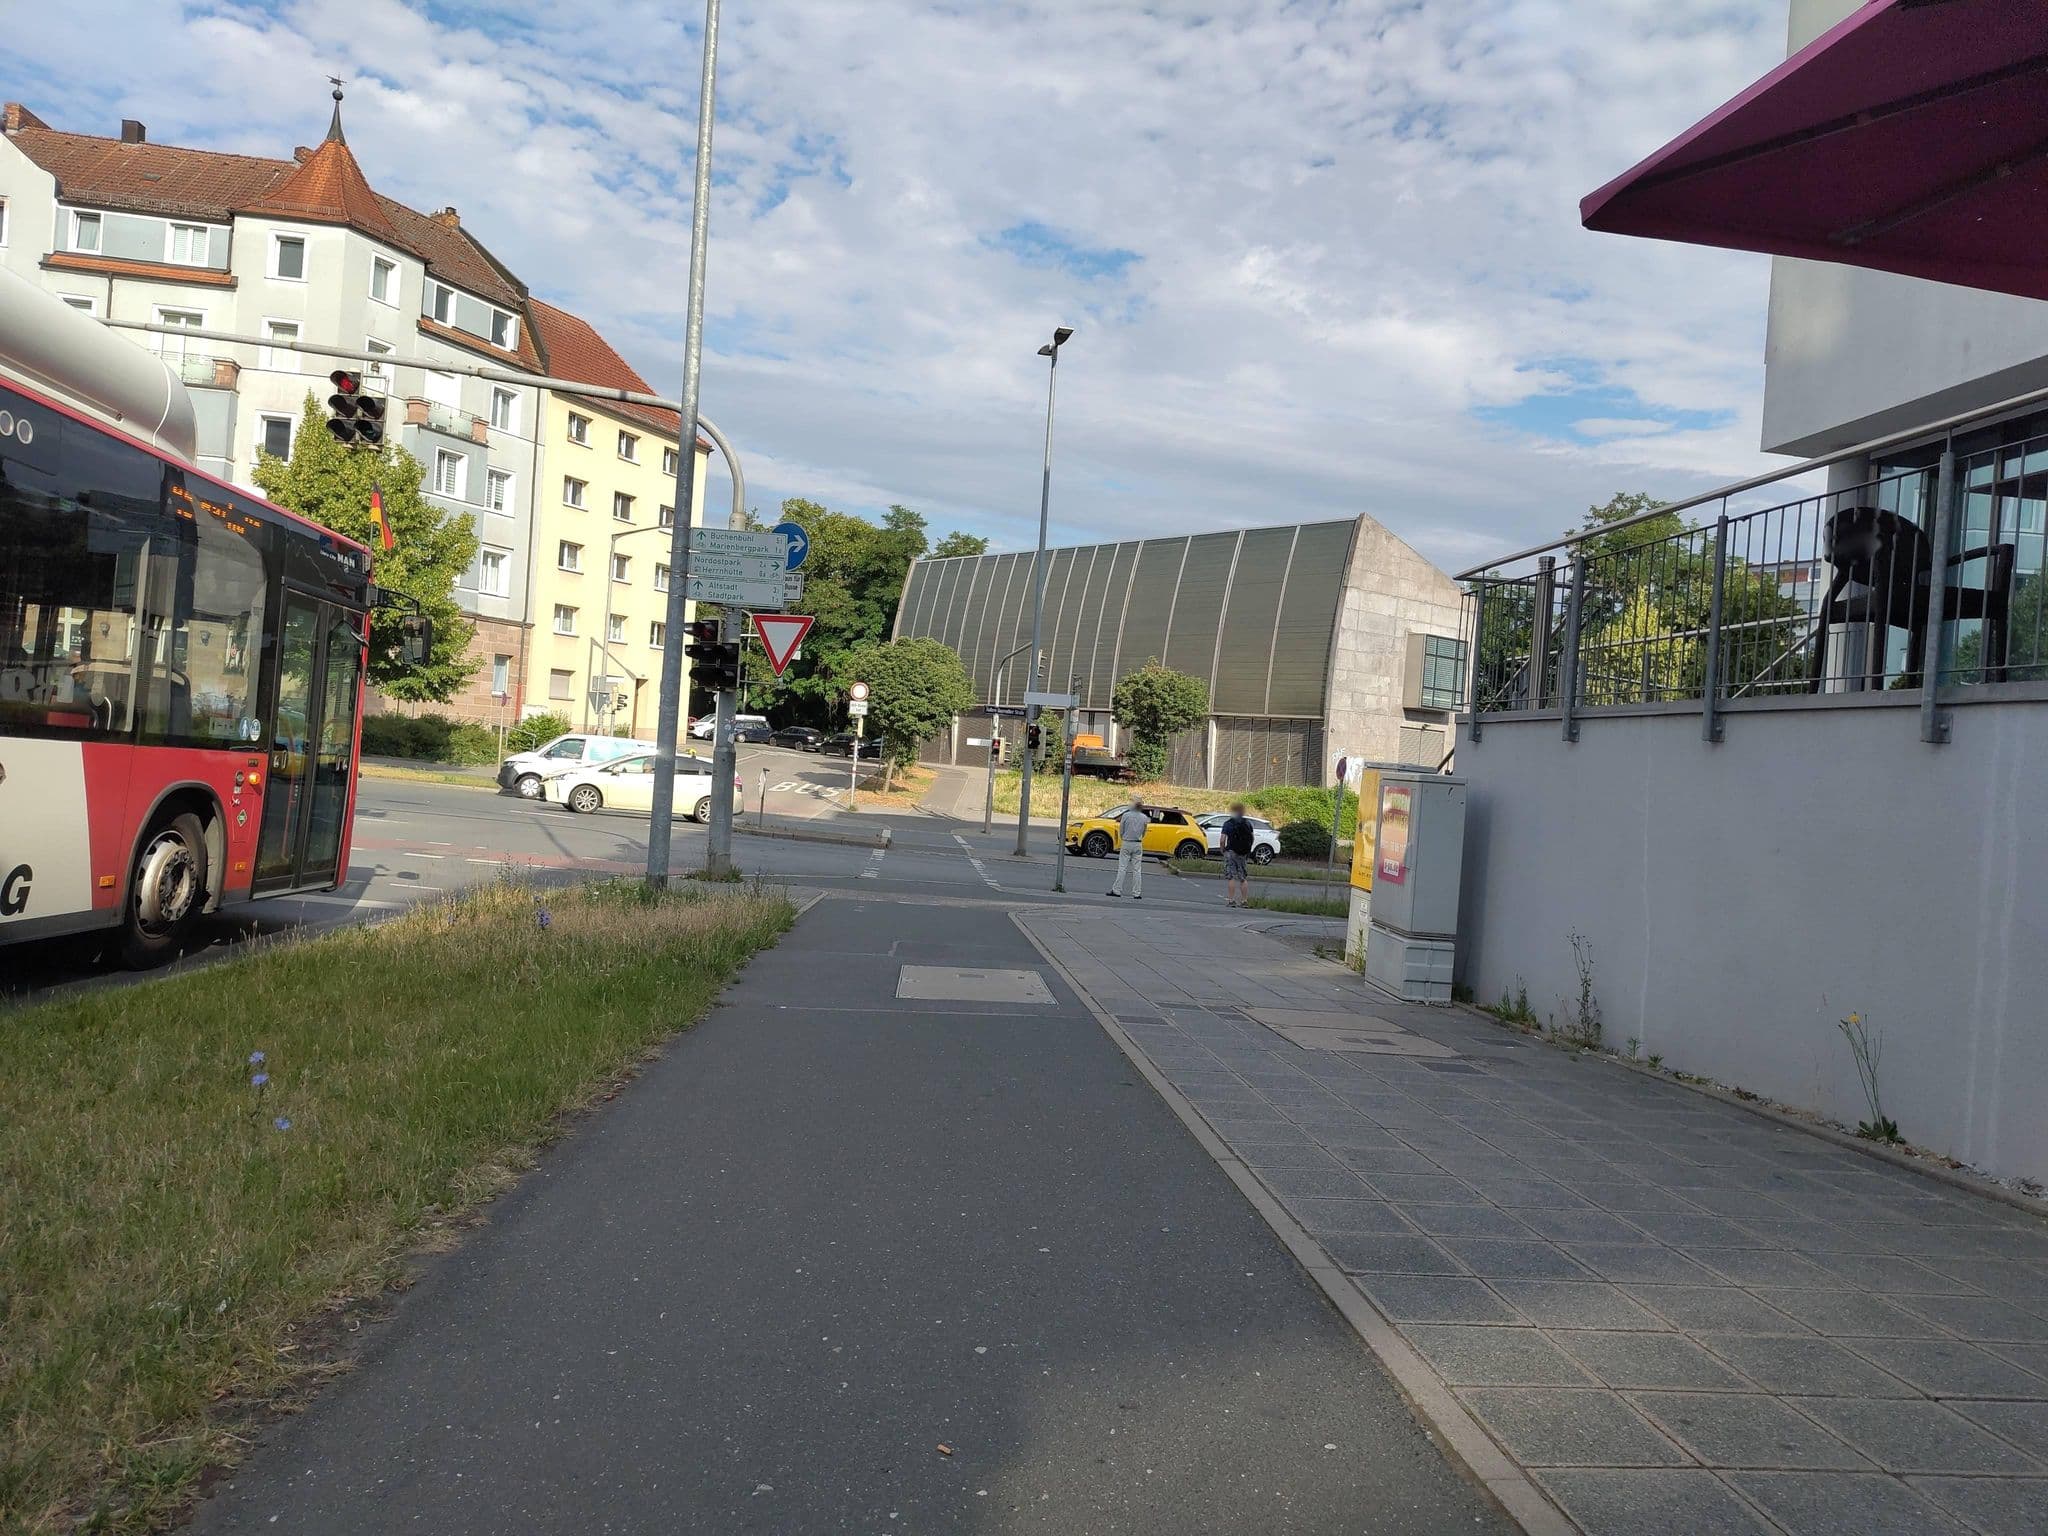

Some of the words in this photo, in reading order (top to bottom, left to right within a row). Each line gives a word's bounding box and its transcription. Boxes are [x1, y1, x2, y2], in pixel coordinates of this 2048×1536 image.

[337, 552, 355, 569] MAN
[694, 555, 742, 567] Nordostpark
[708, 581, 738, 591] Altstadt
[707, 590, 744, 601] Stadtpark
[768, 781, 845, 797] BUS
